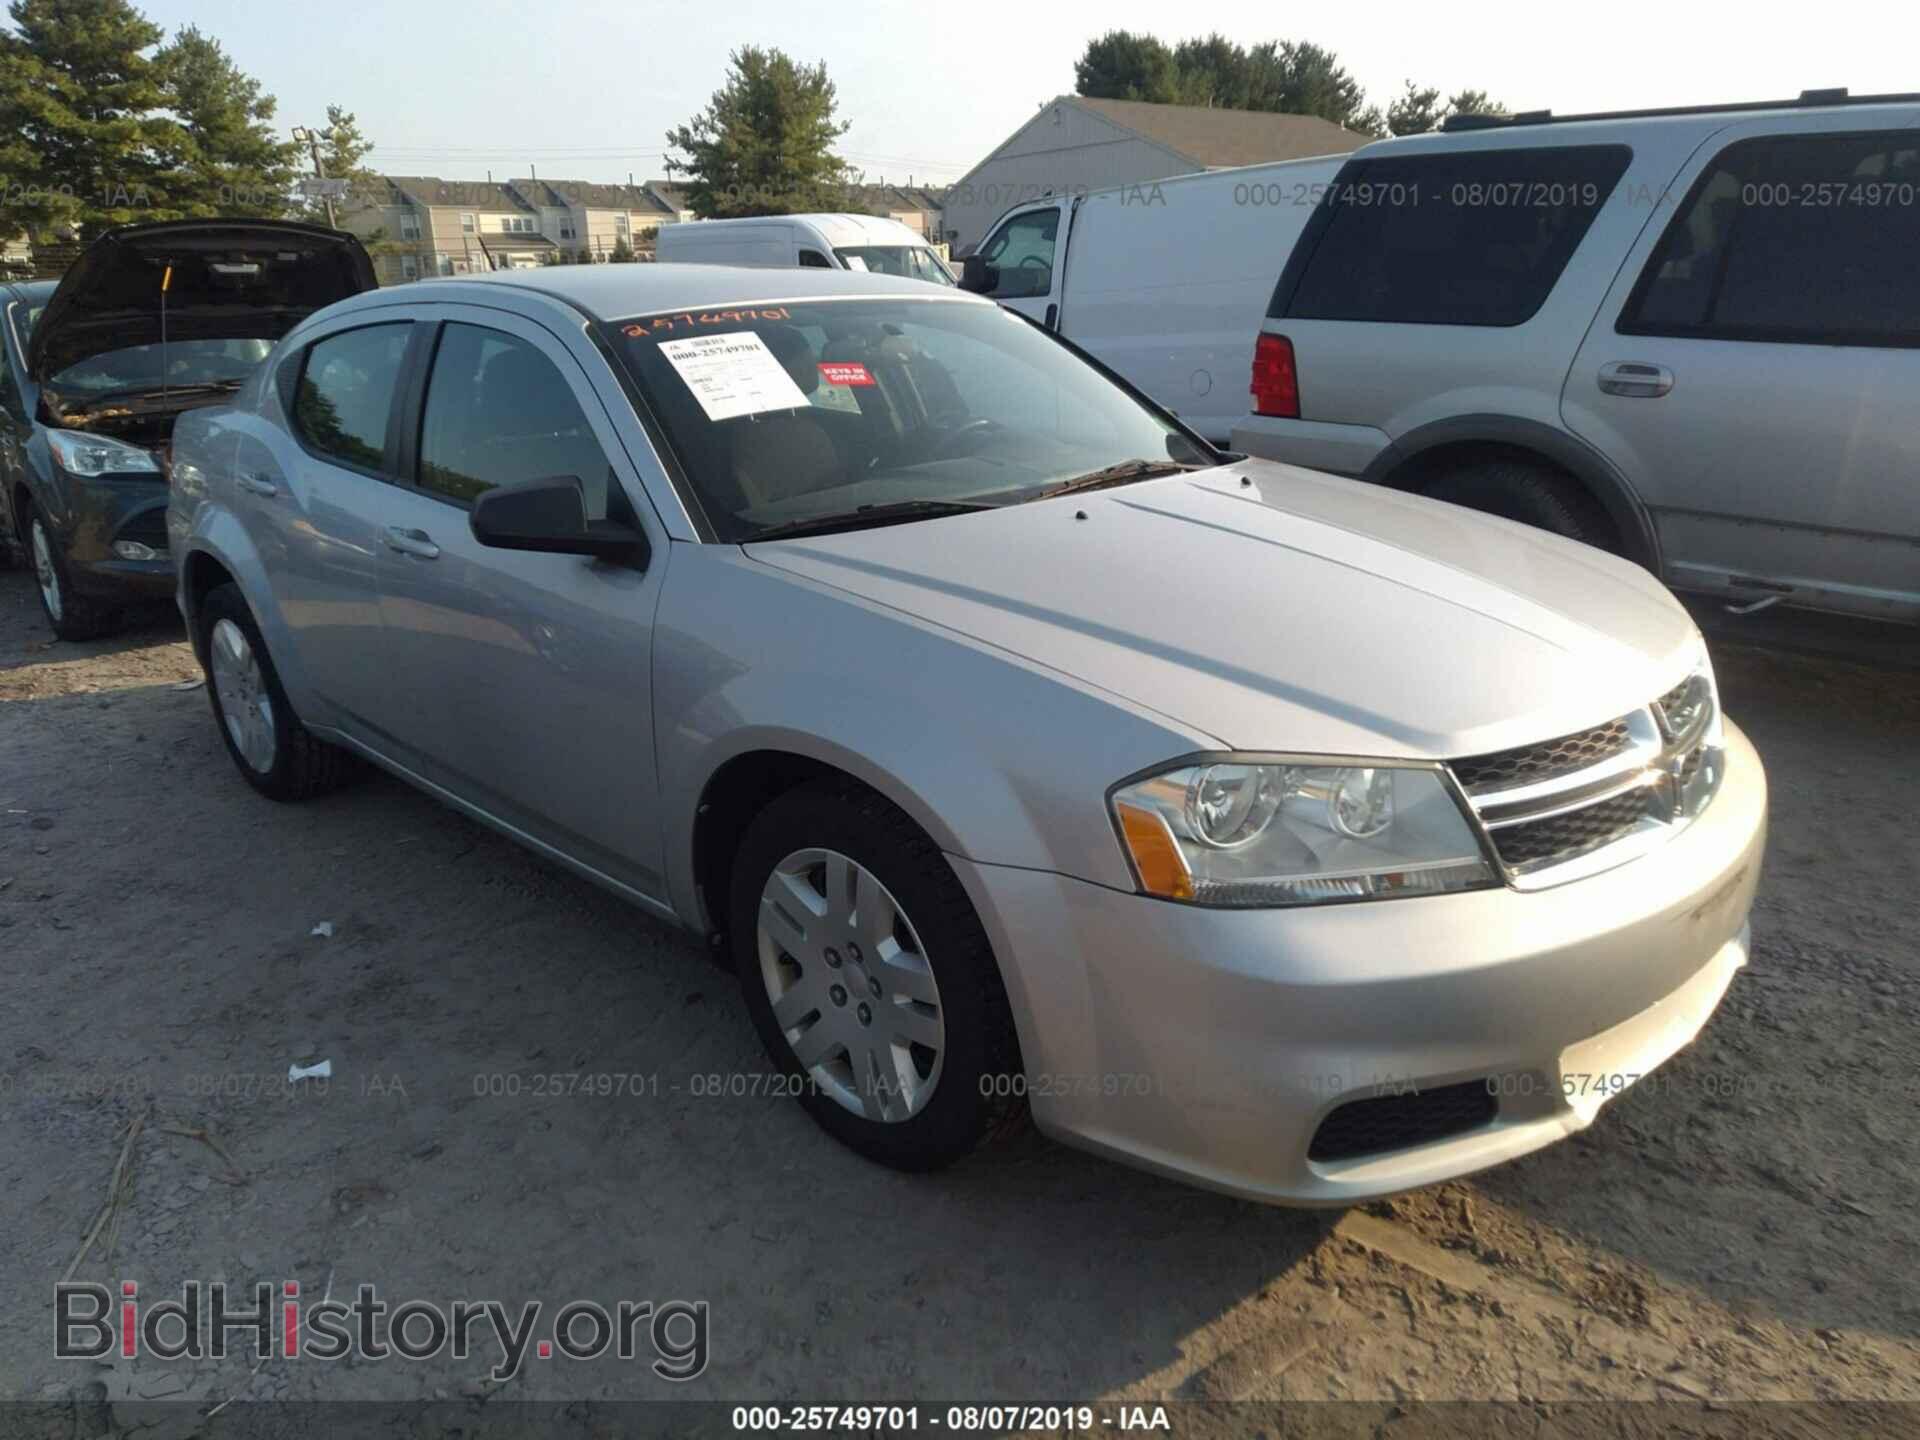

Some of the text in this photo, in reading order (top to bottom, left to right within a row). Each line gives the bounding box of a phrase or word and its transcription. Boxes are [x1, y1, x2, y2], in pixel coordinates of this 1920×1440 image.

[824, 368, 865, 376] KEYS IN
[830, 374, 867, 382] OFFICE
